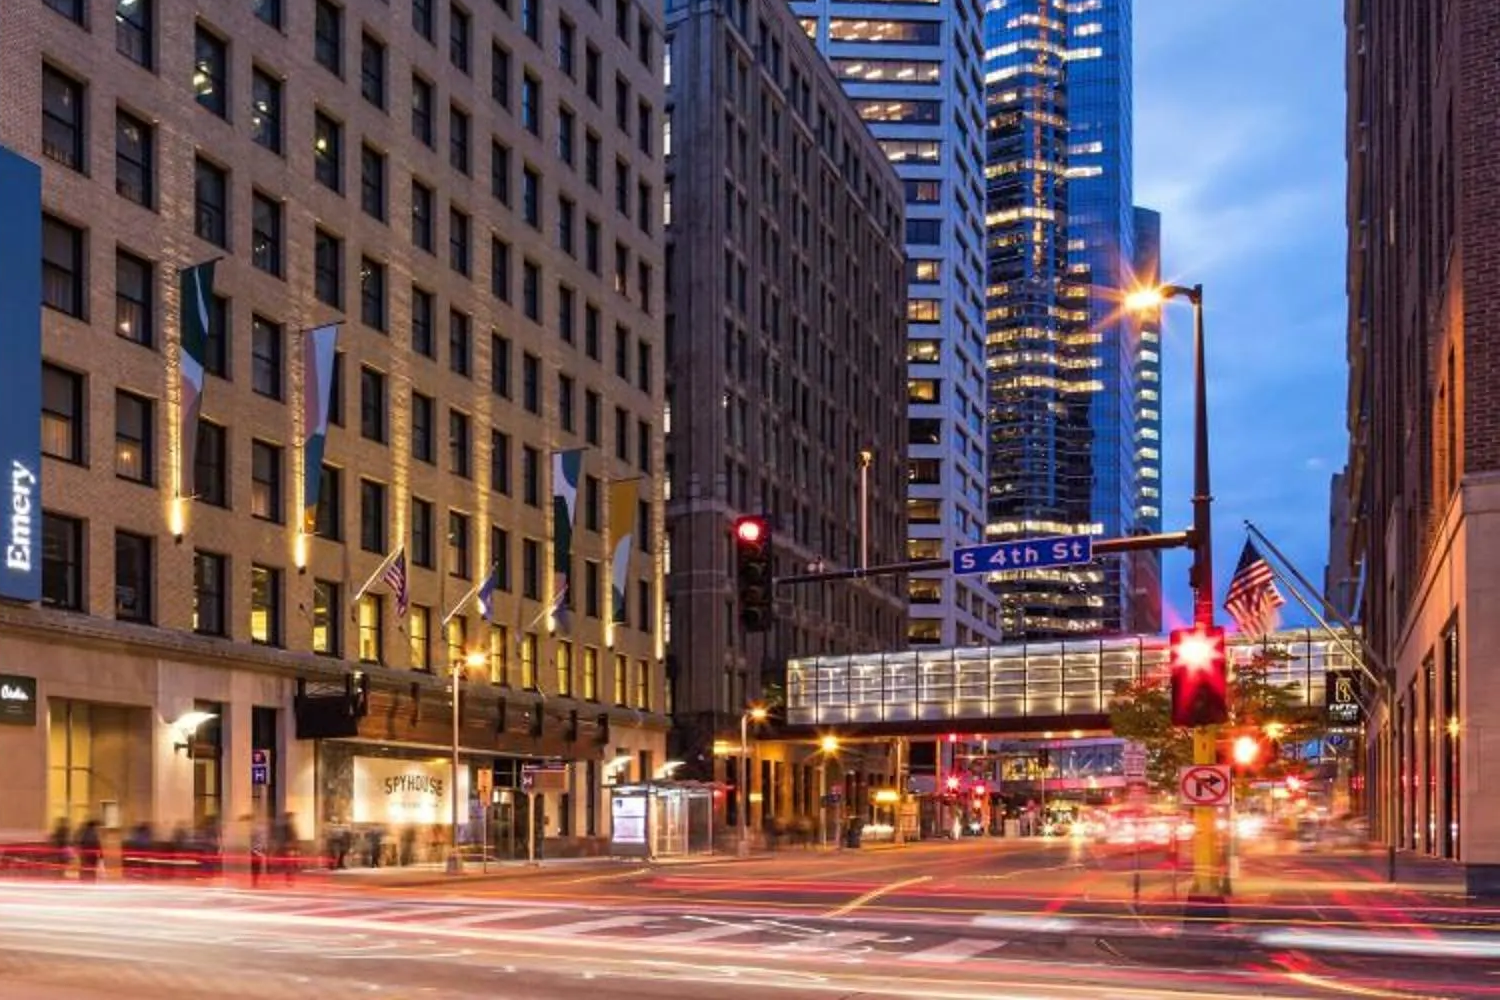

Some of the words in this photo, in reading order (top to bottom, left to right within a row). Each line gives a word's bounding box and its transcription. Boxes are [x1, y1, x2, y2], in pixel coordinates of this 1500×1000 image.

[7, 460, 36, 571] Emery
[961, 552, 976, 569] S
[989, 546, 1039, 565] 4th
[1052, 541, 1082, 560] St
[384, 775, 443, 797] SPYHOUSE
